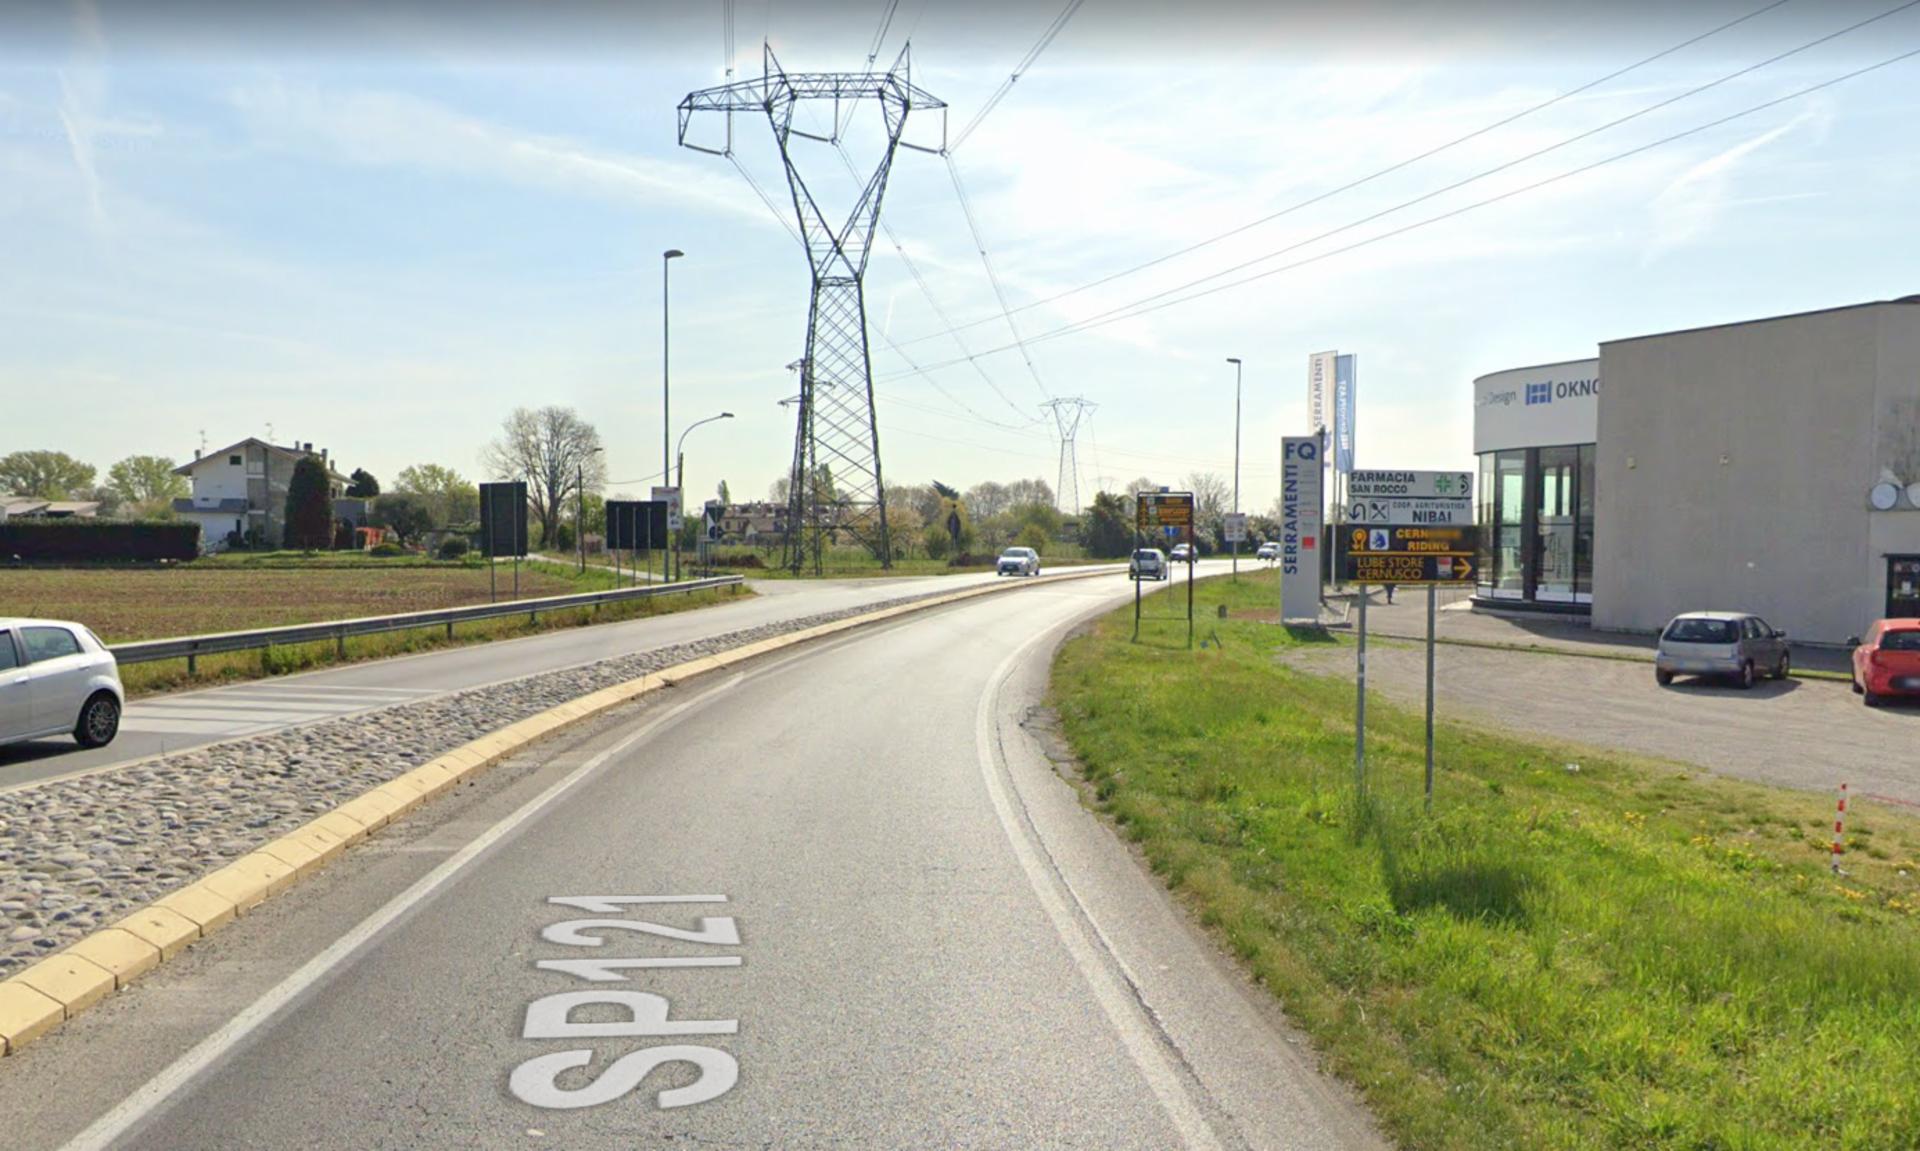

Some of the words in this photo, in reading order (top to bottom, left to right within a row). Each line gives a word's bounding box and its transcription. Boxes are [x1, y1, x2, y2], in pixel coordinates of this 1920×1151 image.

[1313, 358, 1323, 427] SERRAMENTI
[1285, 442, 1316, 460] FQ
[1351, 472, 1416, 483] FARMACIA
[1351, 484, 1370, 493] SAN
[1374, 484, 1407, 494] ROCCO
[1284, 464, 1297, 575] SERRAMENTI
[1412, 510, 1452, 522] NIBAI
[1407, 541, 1449, 551] RIDING
[1357, 557, 1387, 569] LUBE
[1388, 557, 1424, 569] STORE
[1356, 568, 1422, 579] CERNUSCO
